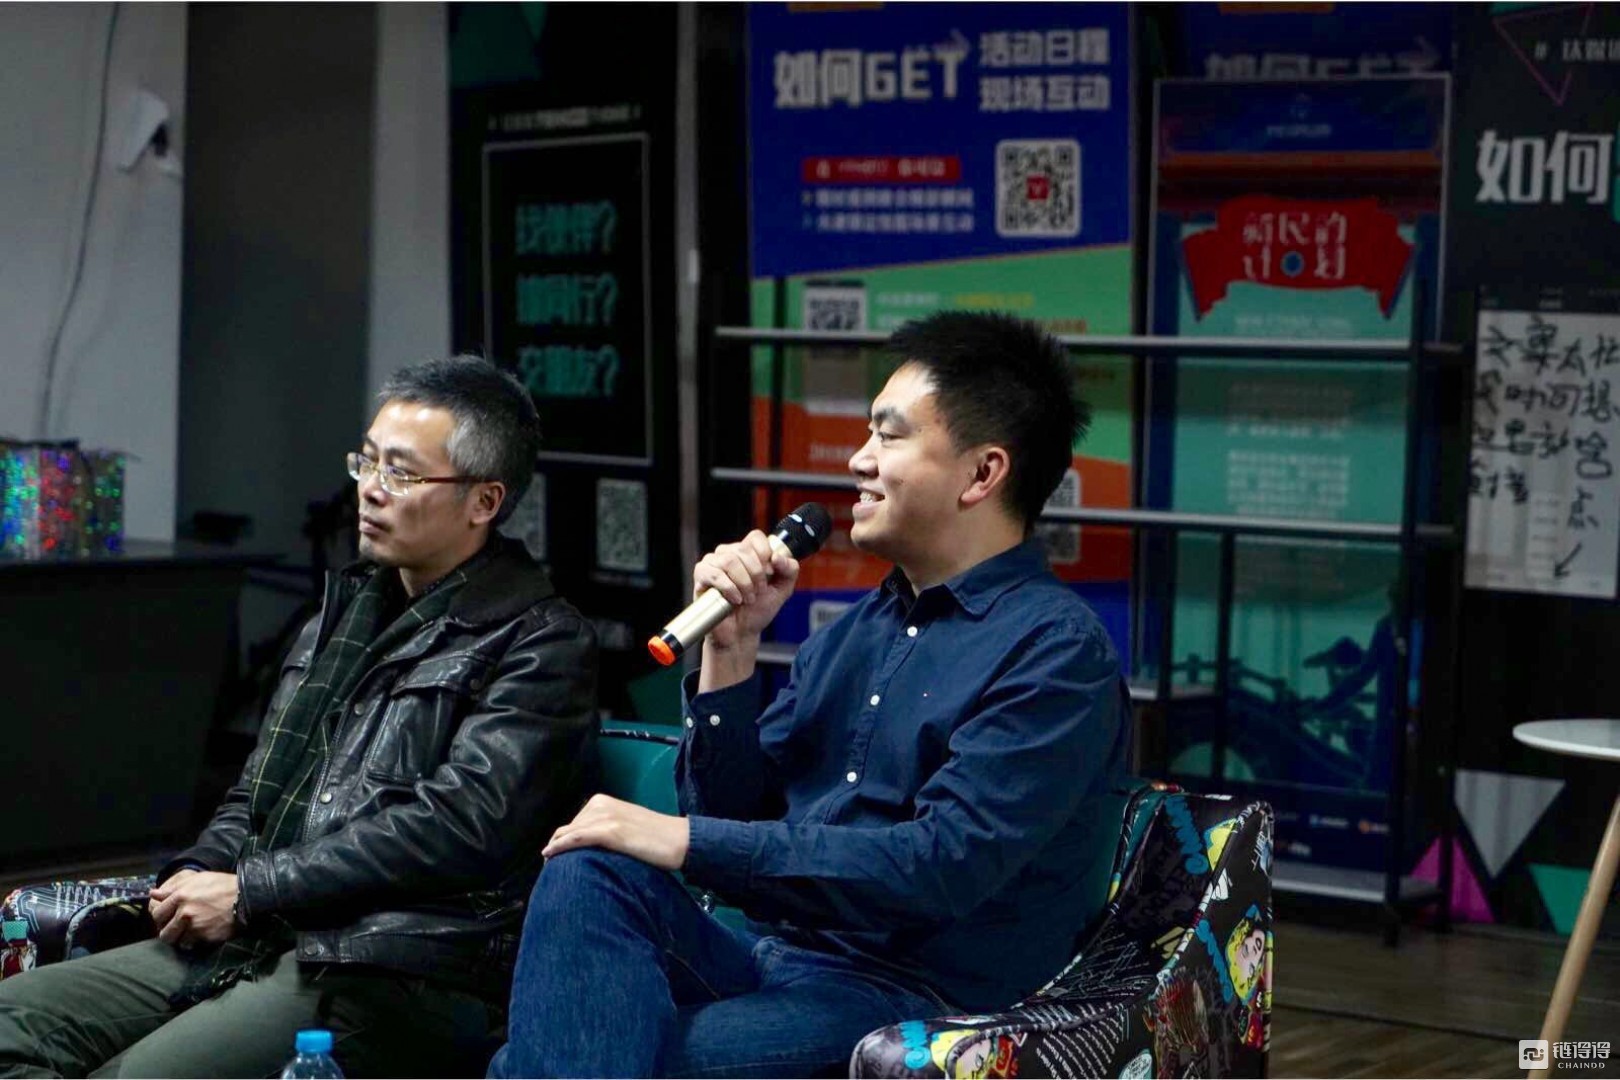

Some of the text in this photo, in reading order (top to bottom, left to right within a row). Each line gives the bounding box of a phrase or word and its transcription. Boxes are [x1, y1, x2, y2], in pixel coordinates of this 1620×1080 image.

[979, 76, 1111, 112] 现场互动
[1476, 128, 1620, 208] 如何
